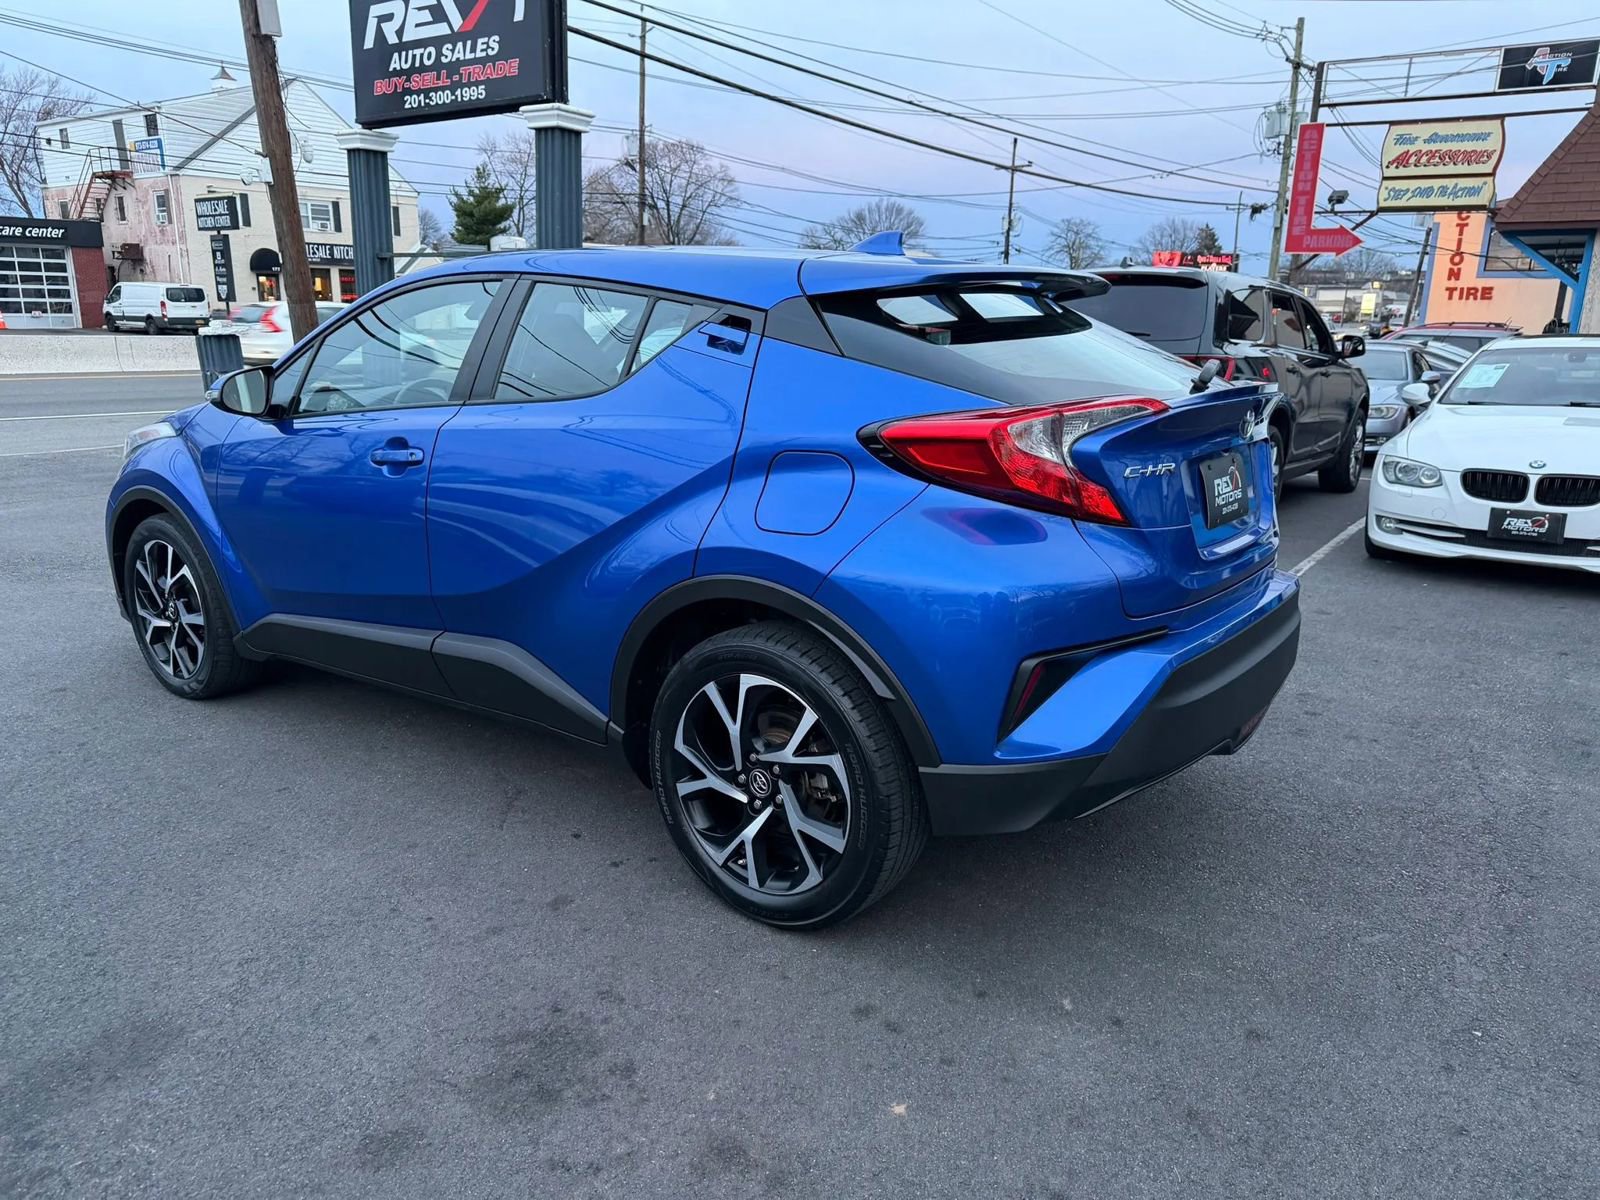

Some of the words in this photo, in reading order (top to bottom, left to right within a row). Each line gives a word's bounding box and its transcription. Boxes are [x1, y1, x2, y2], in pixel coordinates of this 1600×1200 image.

[389, 47, 436, 72] AUTO
[440, 35, 500, 64] SALES
[403, 85, 486, 109] 201-300-1995
[1296, 129, 1319, 192] ACTION
[1385, 149, 1497, 169] ACCESSORIES
[195, 199, 229, 216] WHOLESALE
[1291, 195, 1311, 236] TIRE
[197, 216, 215, 228] KITCHEN
[215, 215, 231, 227] CENTER
[0, 225, 22, 236] are
[25, 226, 65, 238] center
[1302, 233, 1353, 248] PARKING
[1445, 286, 1494, 301] TIRE
[1124, 462, 1176, 479] C-HR
[1214, 488, 1243, 507] MOTORS
[1501, 525, 1547, 533] MOTORS
